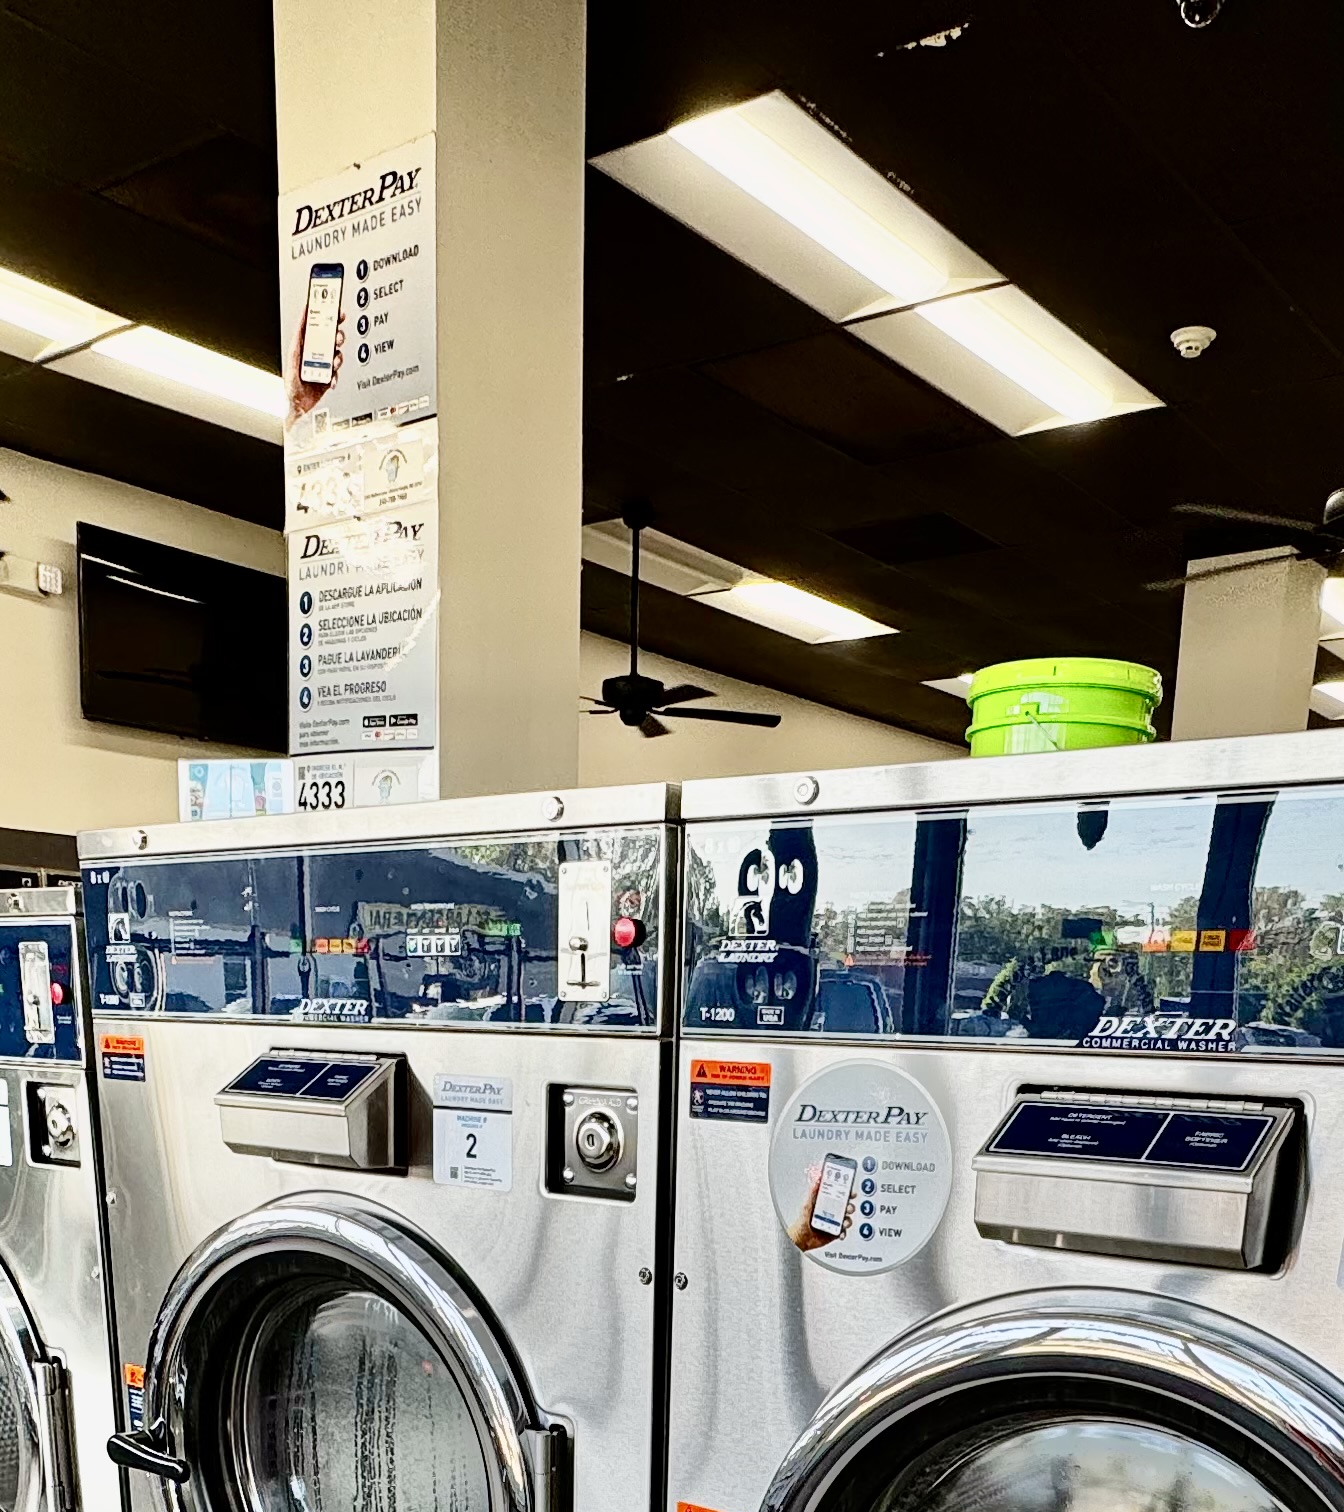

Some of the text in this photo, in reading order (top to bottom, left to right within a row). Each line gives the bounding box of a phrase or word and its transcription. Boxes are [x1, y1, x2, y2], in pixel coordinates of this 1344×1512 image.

[292, 197, 422, 260] LAUNDRY MADE EASY
[373, 244, 419, 272] DOWNLOAD
[373, 280, 404, 301] SELECT
[374, 312, 389, 327] PAY
[374, 340, 395, 355] VIEW
[357, 364, 419, 391] Visit DexterPay.com
[318, 583, 363, 602] DESCARGUE
[364, 583, 375, 596] LA
[318, 613, 365, 631] SELECCIONE
[366, 612, 376, 626] LA
[378, 604, 422, 625] UBICACIÓN
[318, 652, 342, 665] PAGUE
[344, 651, 354, 663] LA
[318, 685, 331, 698] VEA
[333, 684, 342, 697] EL
[344, 680, 387, 696] PROGRESO
[298, 780, 346, 811] 4333
[719, 940, 777, 951] DEXTER
[718, 952, 777, 963] LAUNDRY
[298, 999, 369, 1016] DEXTER
[700, 1007, 735, 1022] T-1200
[762, 1014, 779, 1022] USA
[1088, 1016, 1237, 1041] DEXTER
[1082, 1037, 1236, 1052] COMMERCIAL WASHER
[719, 1065, 757, 1075] WARNING
[792, 1128, 929, 1143] LAUNDRY MADE EASY
[466, 1133, 477, 1158] 2
[881, 1161, 935, 1173] DOWNLOAD
[880, 1184, 916, 1195] SELECT
[879, 1205, 898, 1215] PAY
[878, 1228, 903, 1238] VIEW
[825, 1252, 883, 1263] Visit DexterPay.com
